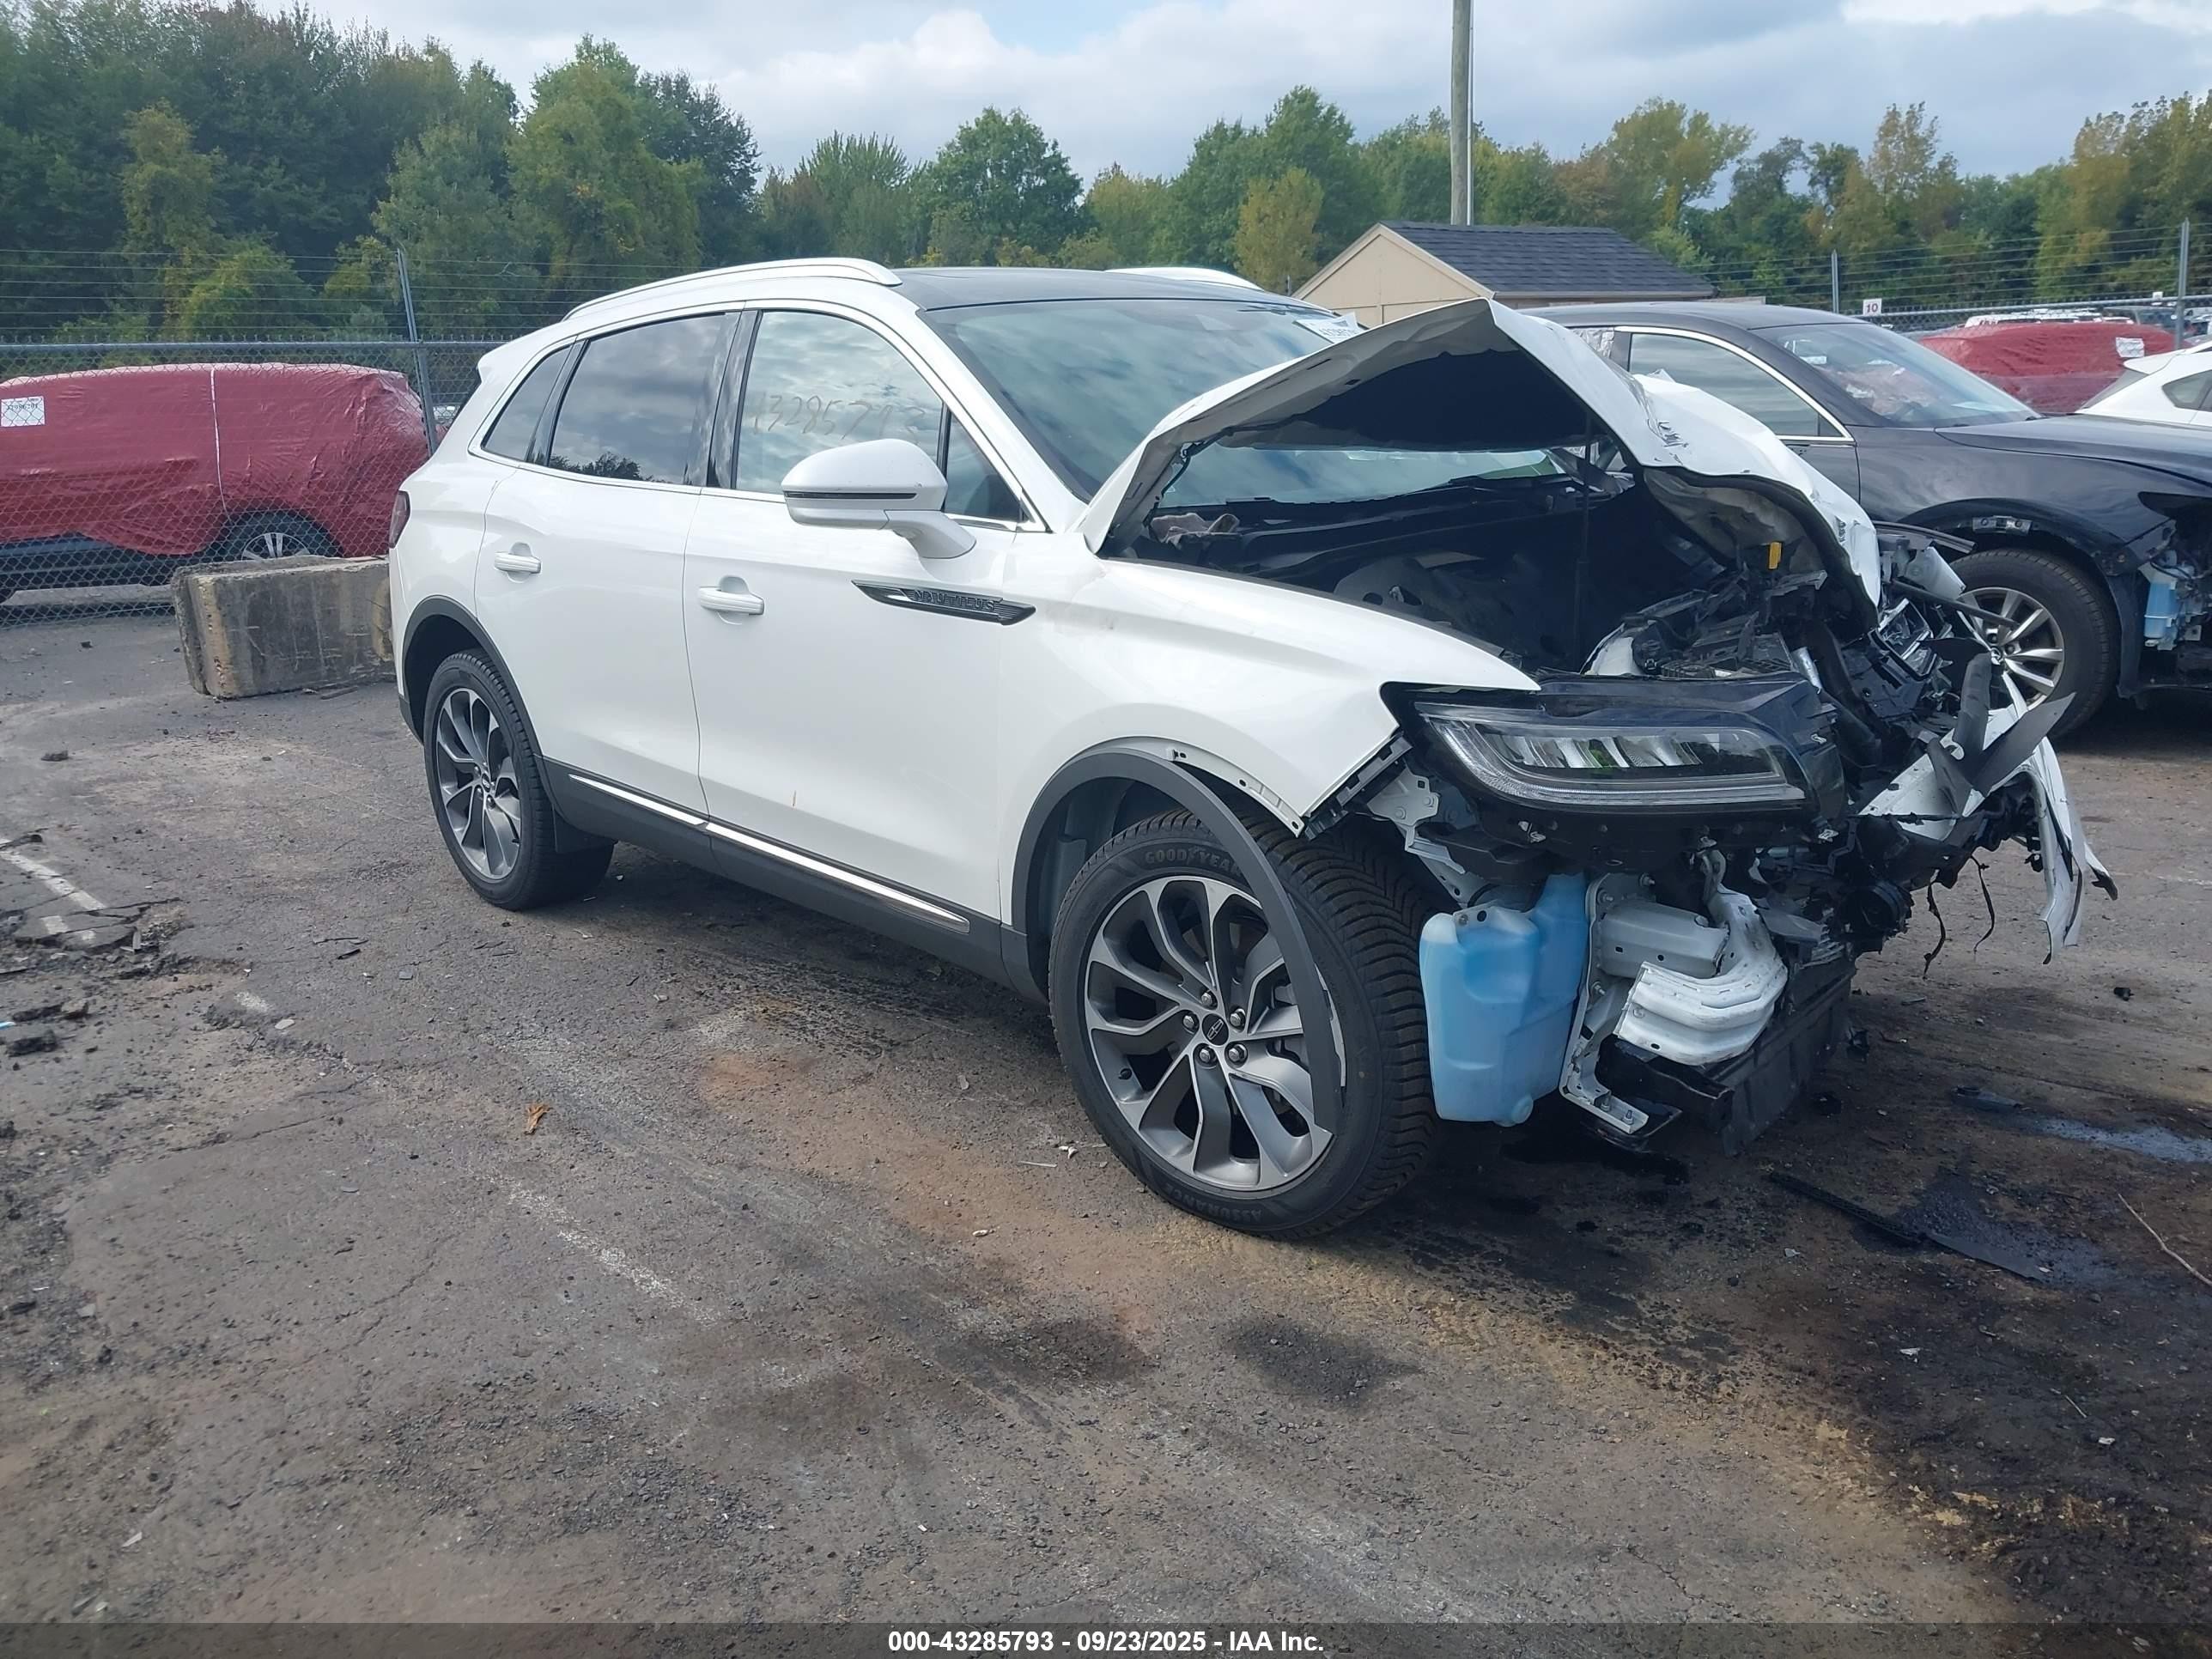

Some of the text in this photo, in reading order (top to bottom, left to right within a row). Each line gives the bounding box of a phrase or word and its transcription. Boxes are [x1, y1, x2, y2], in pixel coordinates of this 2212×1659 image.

[1866, 303, 1879, 313] 10
[914, 588, 995, 611] NAUTILUS
[1164, 1182, 1263, 1223] ASSURANCE
